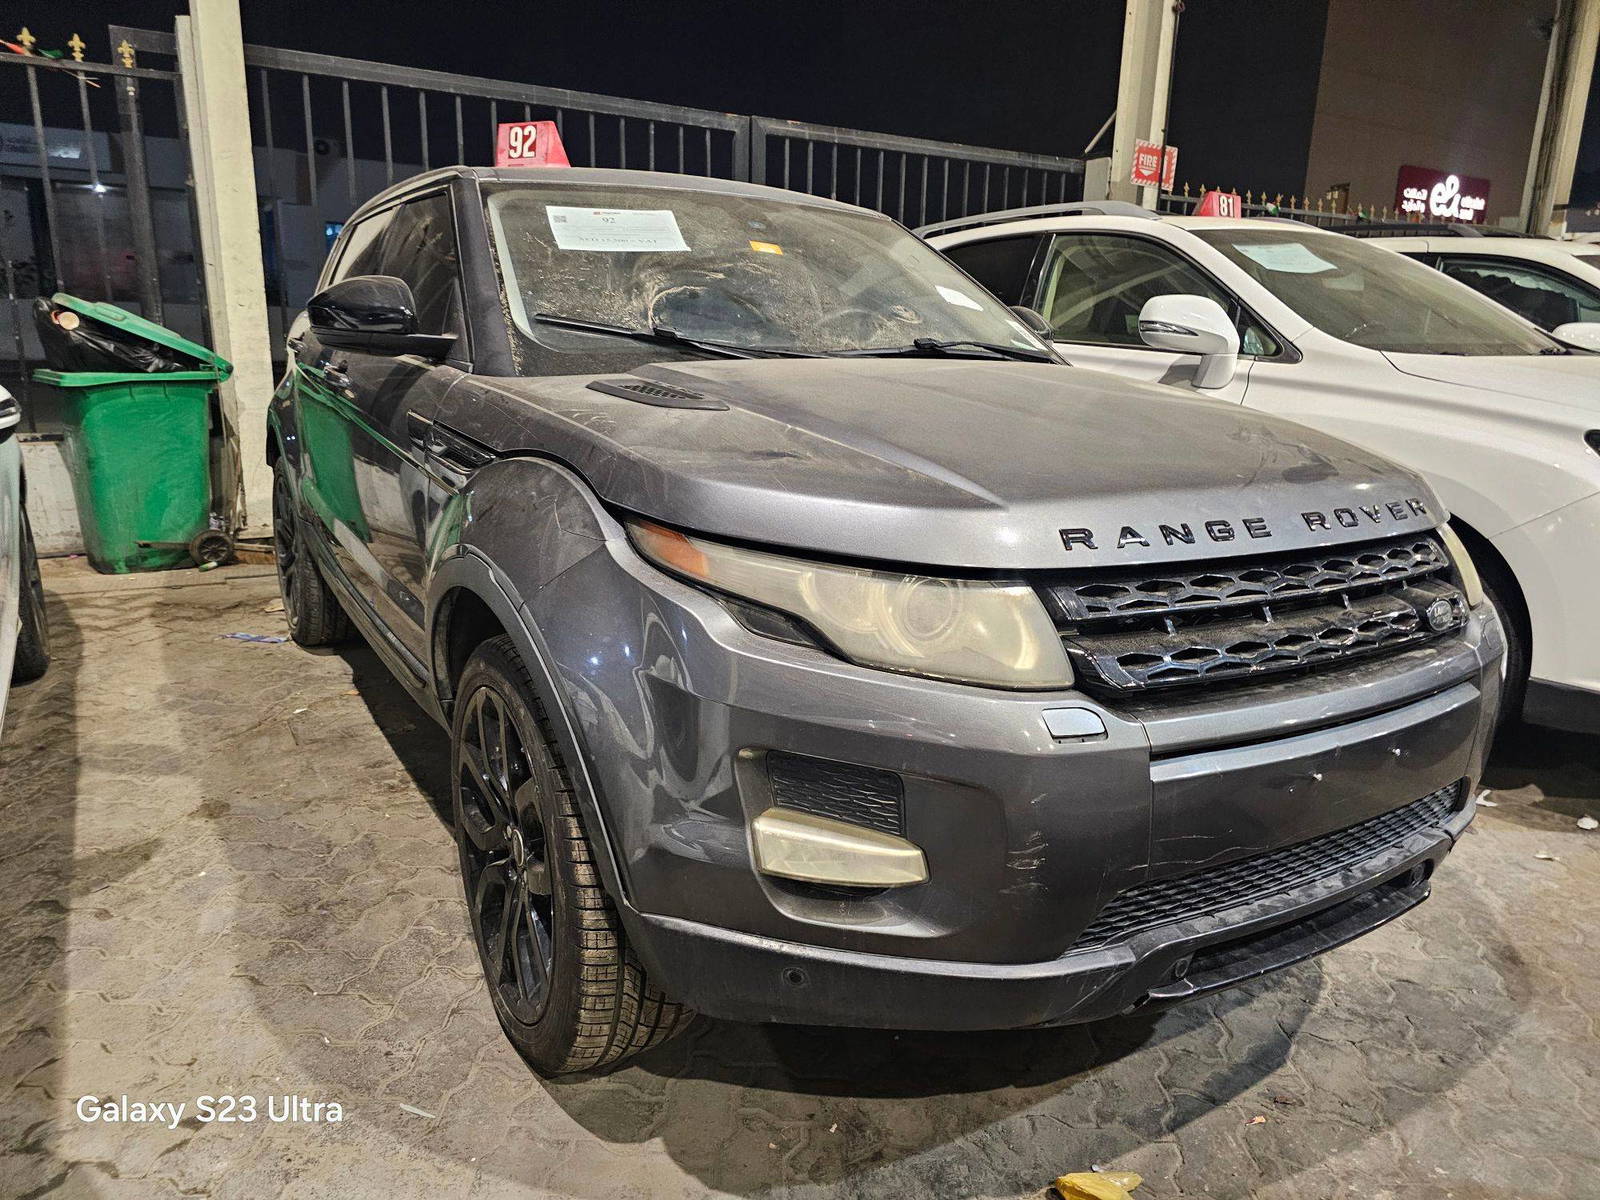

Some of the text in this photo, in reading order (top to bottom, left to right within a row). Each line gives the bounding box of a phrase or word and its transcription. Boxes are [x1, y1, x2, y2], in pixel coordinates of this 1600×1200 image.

[508, 125, 537, 159] 92
[1138, 152, 1158, 168] FIRE
[1219, 195, 1235, 217] 81
[601, 216, 616, 224] 92
[1058, 497, 1429, 552] RANGE ROVER
